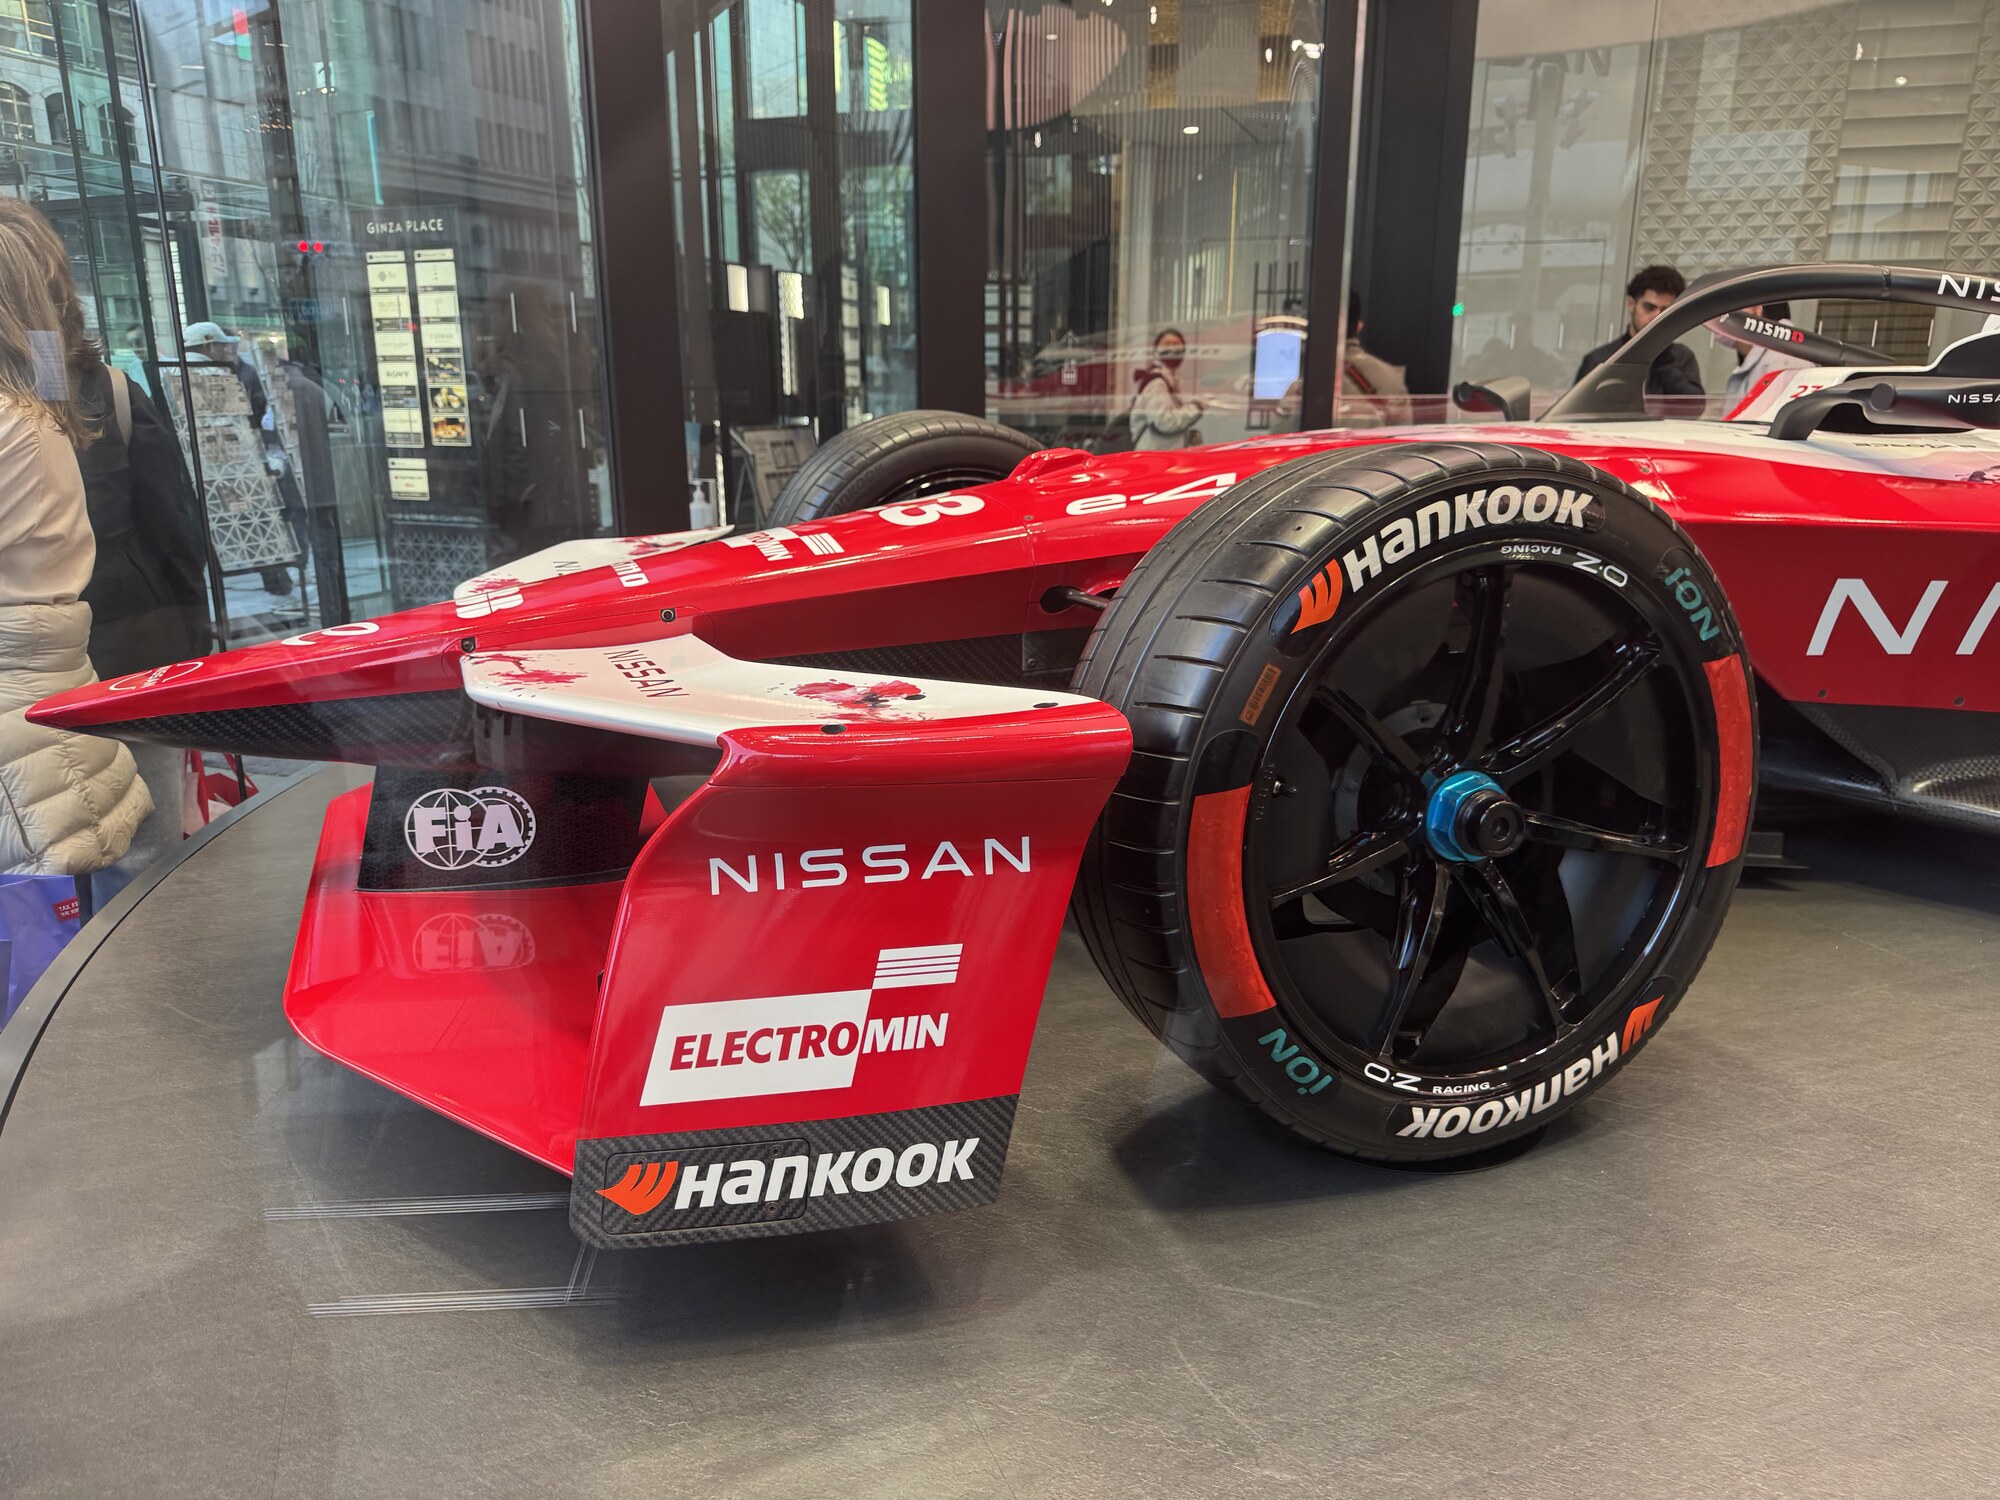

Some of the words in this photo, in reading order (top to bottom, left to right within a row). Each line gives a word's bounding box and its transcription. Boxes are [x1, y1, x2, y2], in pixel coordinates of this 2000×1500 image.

[366, 222, 403, 234] GINZA
[405, 219, 444, 232] PLACE
[1501, 545, 1562, 555] RACING
[603, 649, 690, 697] NISSAN
[709, 836, 1031, 896] NISSAN
[58, 904, 71, 912] TAX
[669, 1013, 949, 1071] ELECTROMIN
[1432, 1081, 1490, 1094] RACING
